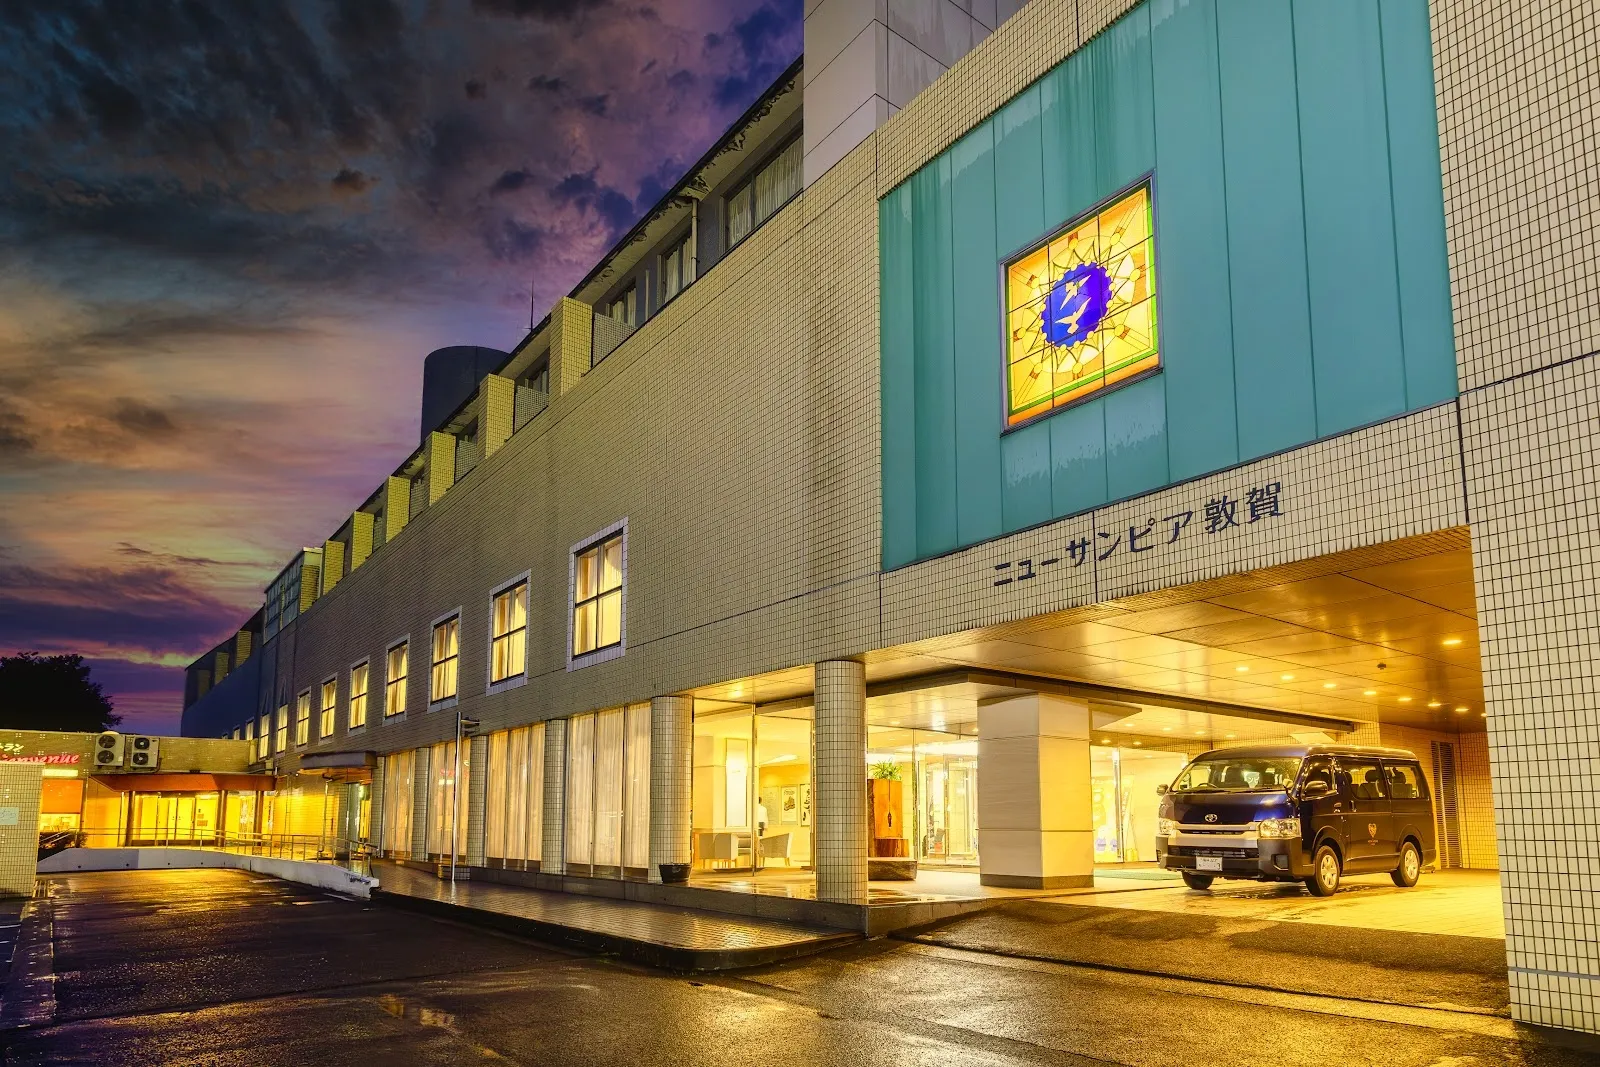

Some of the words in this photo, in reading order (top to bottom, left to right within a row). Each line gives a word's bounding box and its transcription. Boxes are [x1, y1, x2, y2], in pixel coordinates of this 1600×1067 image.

[994, 482, 1284, 587] ニューサンピア敦賀
